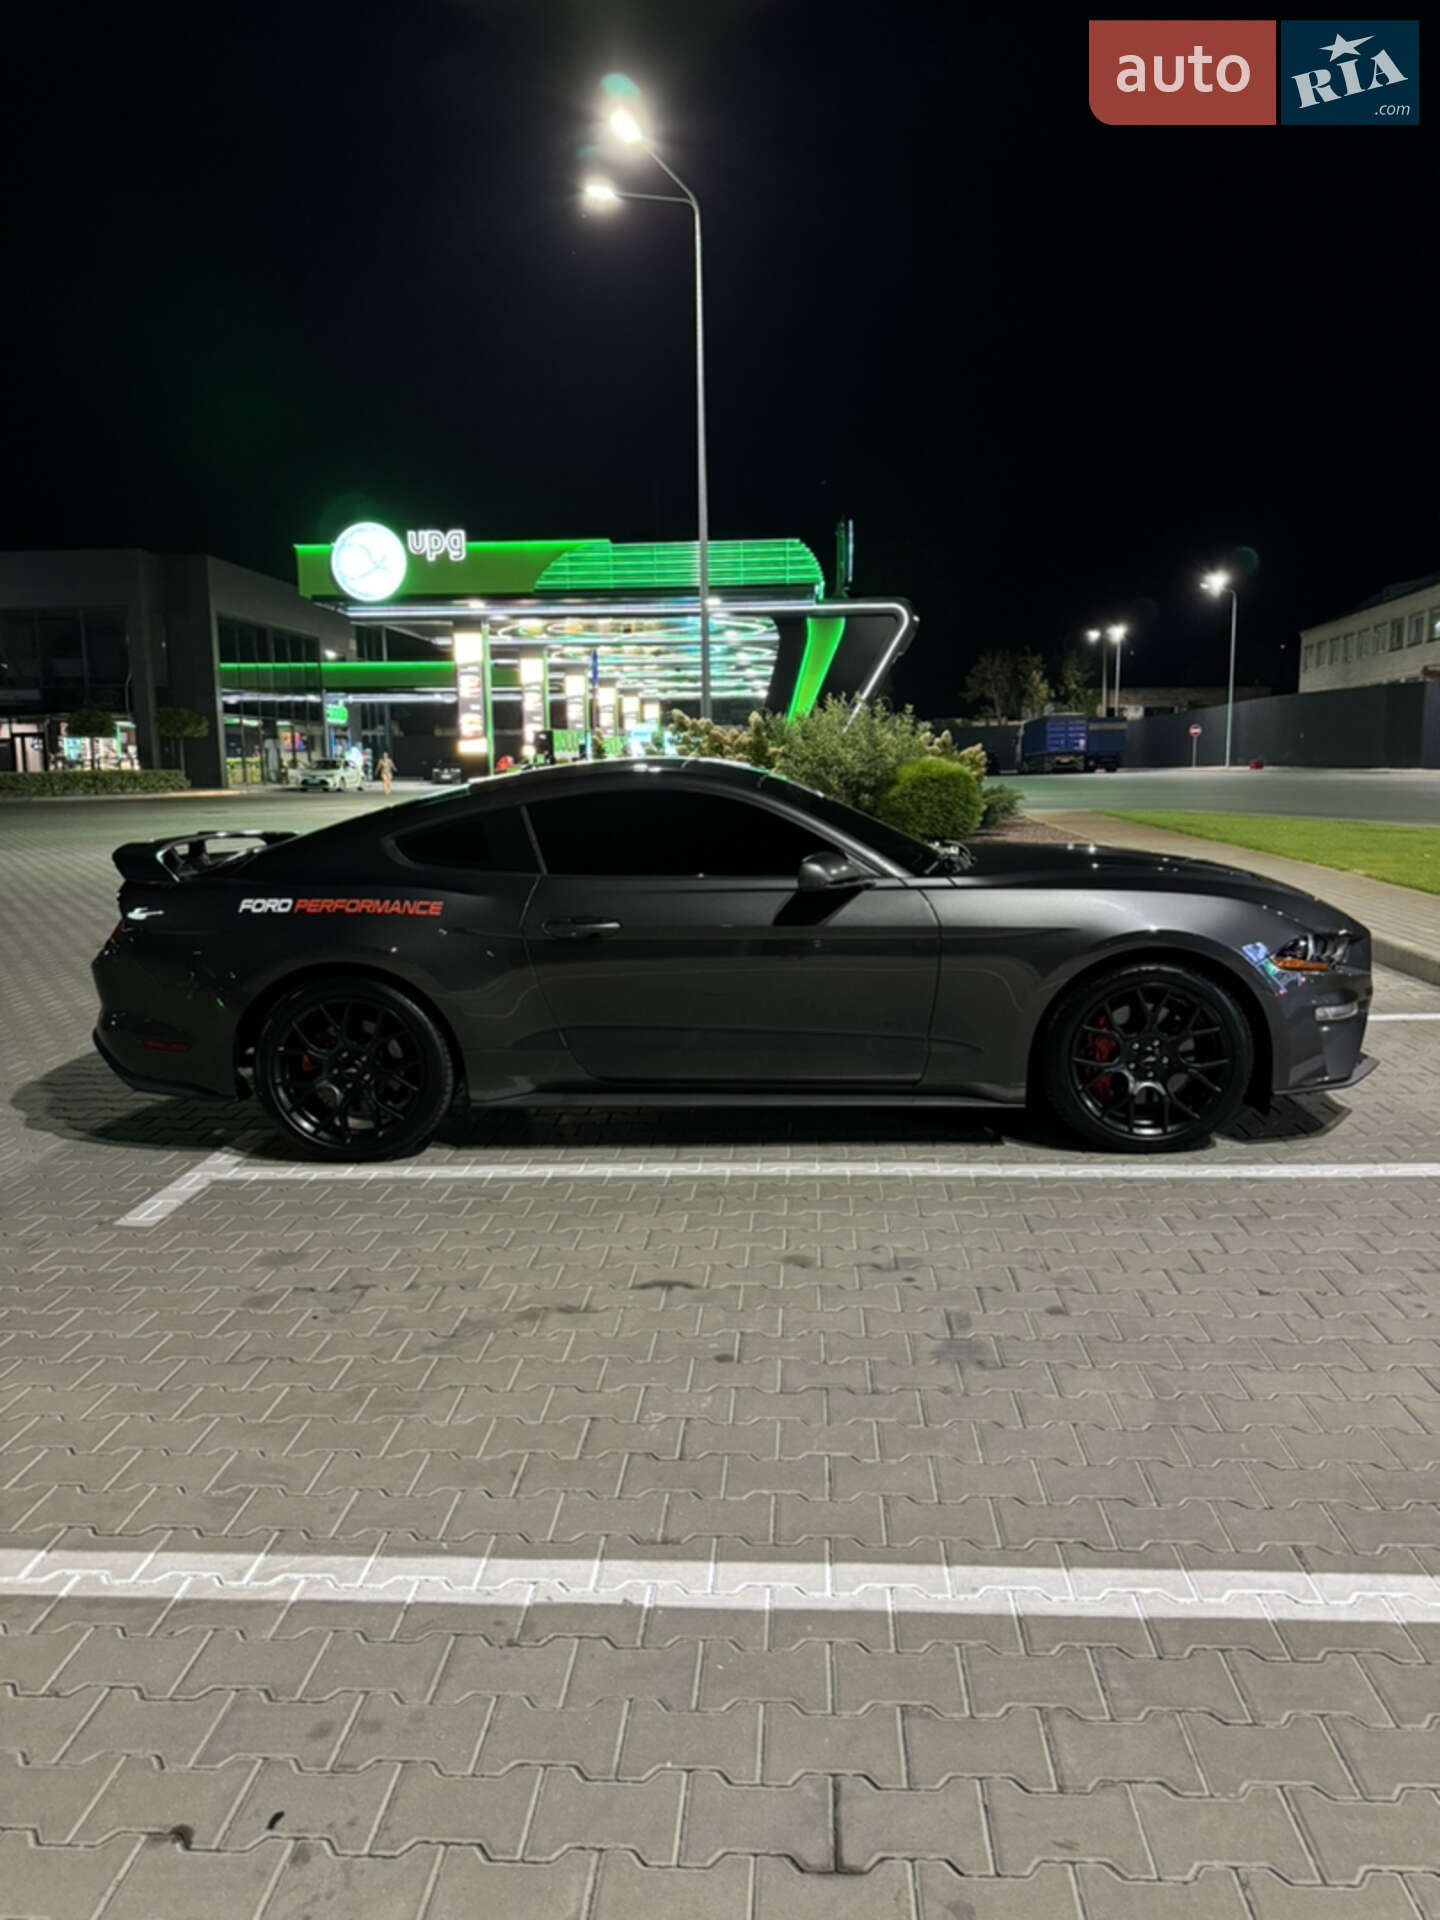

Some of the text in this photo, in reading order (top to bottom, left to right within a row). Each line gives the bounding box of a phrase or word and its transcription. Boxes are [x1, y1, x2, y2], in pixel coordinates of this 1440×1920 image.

[407, 529, 466, 562] upg
[238, 898, 444, 916] FORD PERFORMANCE
